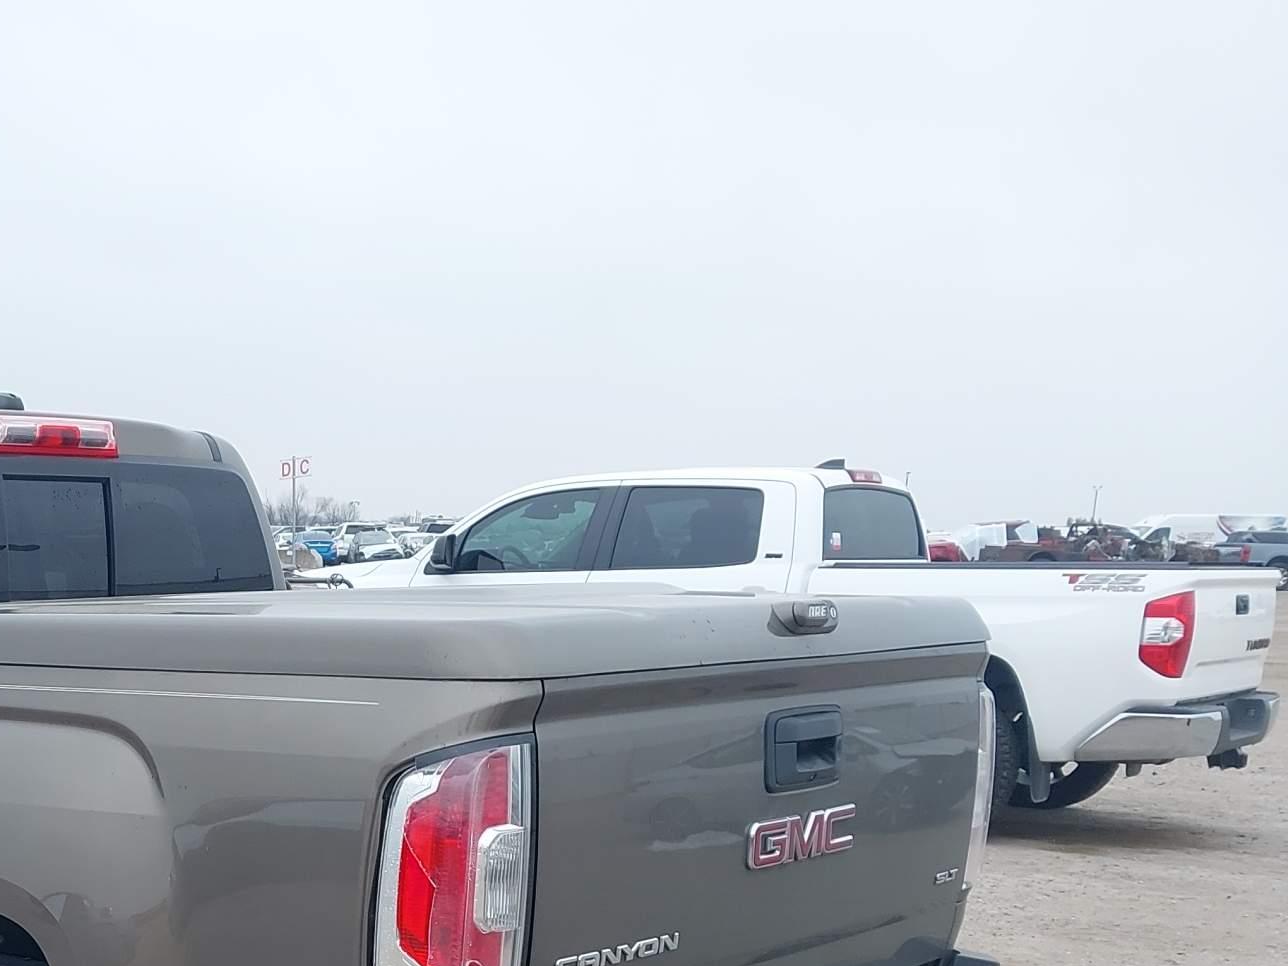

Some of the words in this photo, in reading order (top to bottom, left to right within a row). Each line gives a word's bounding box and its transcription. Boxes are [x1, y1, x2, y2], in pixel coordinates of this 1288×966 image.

[282, 462, 291, 477] D
[300, 459, 310, 474] C
[747, 803, 856, 870] GMC
[935, 868, 959, 885] SLT
